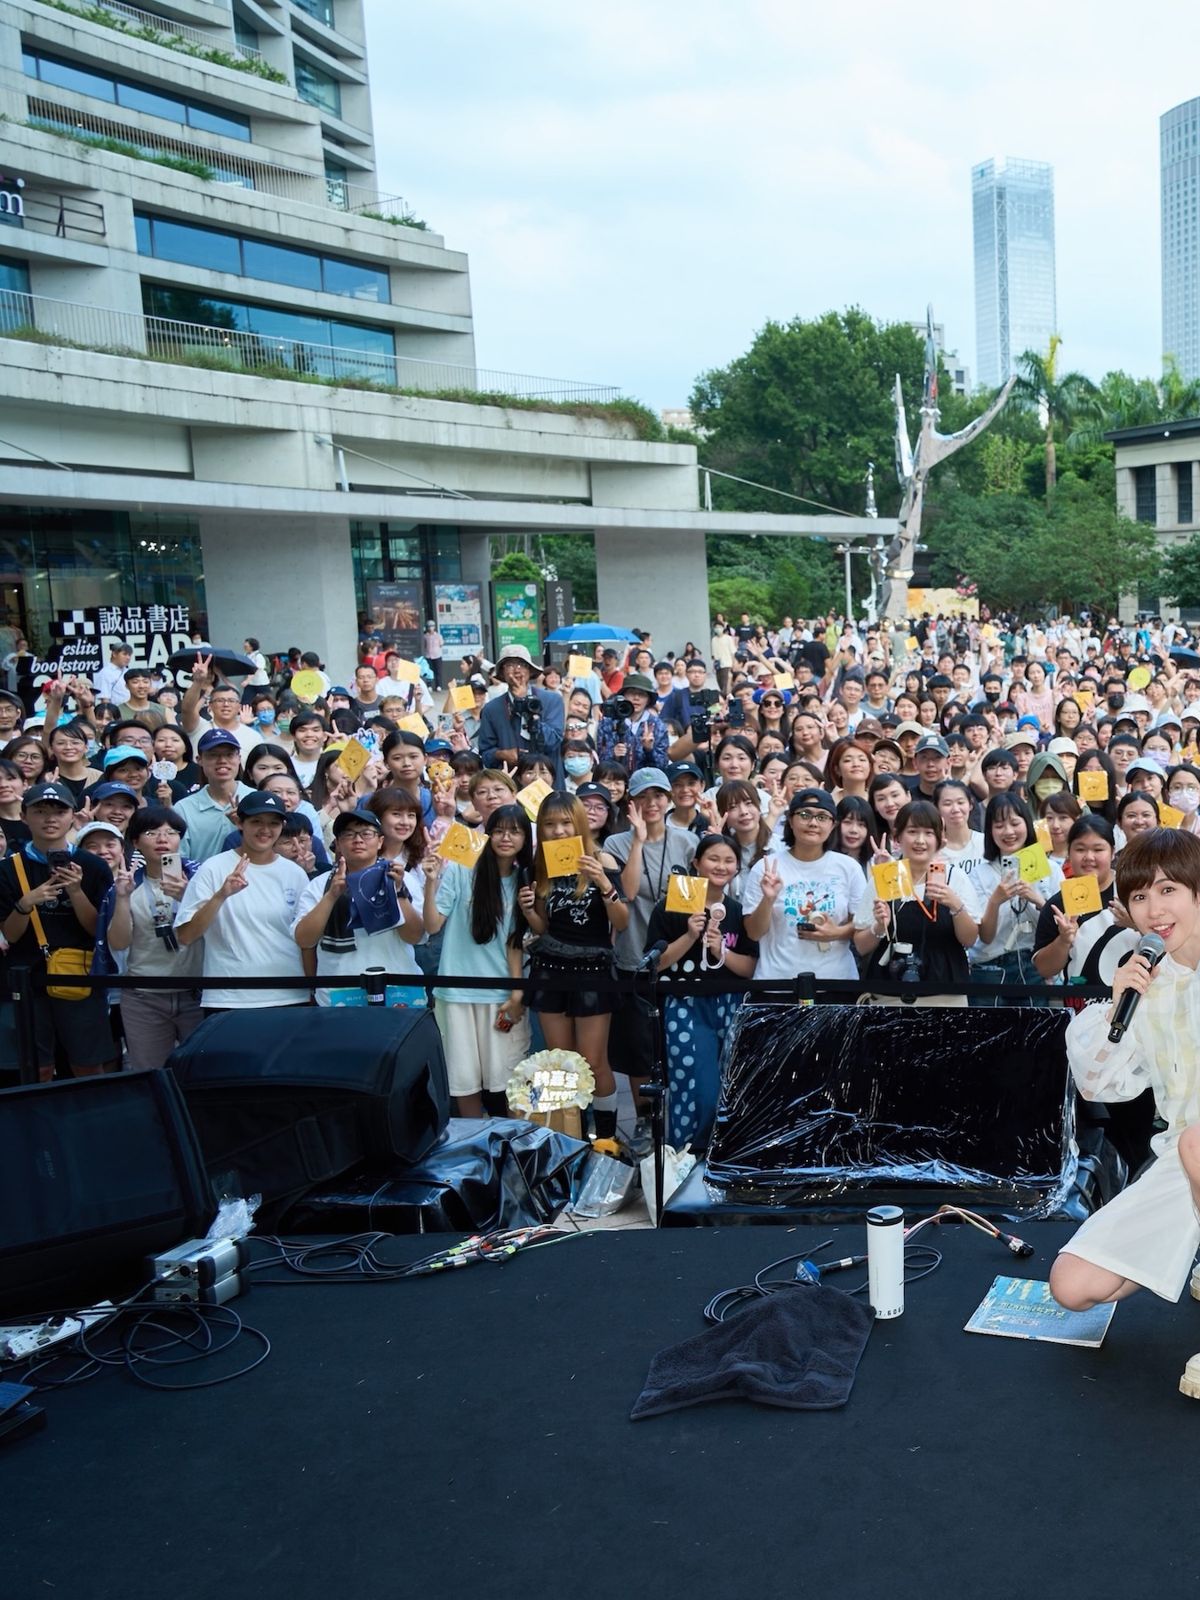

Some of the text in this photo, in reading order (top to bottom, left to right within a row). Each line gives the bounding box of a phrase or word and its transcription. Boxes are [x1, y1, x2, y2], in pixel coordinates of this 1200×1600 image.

[99, 604, 190, 634] 誠品書店
[62, 638, 99, 656] eslite
[31, 656, 100, 674] bookstore
